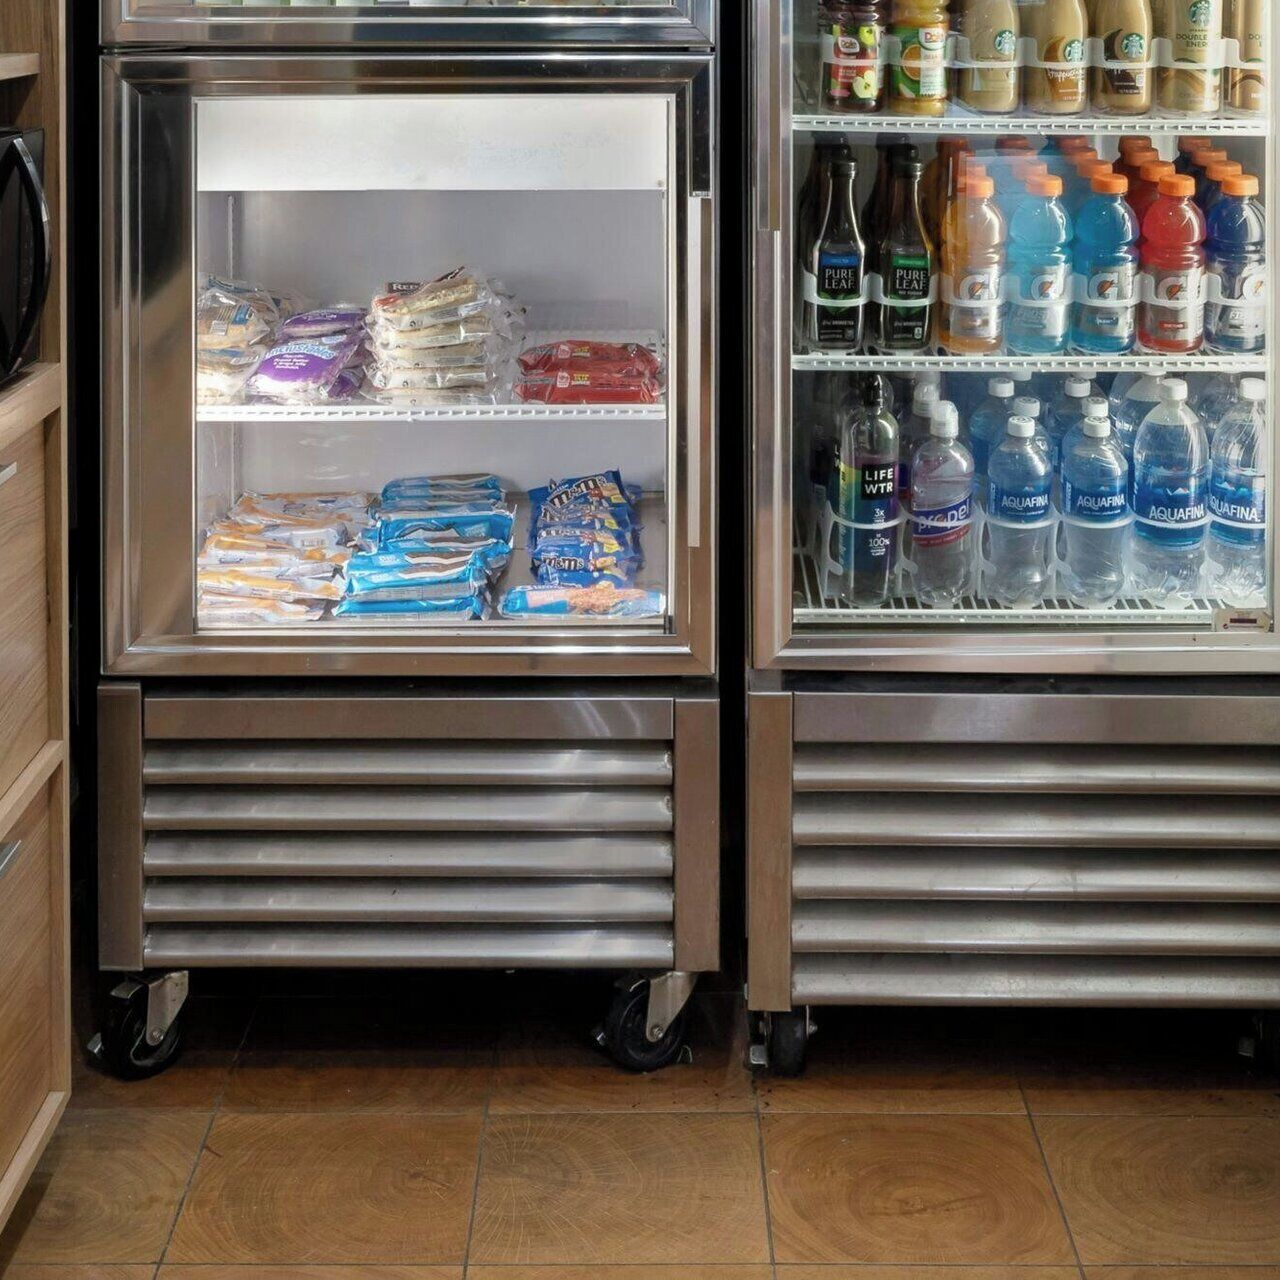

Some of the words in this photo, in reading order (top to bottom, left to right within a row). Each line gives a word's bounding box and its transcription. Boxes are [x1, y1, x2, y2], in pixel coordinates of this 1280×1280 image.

[825, 268, 855, 279] PURE
[896, 268, 927, 280] PURE
[825, 279, 854, 289] LEAF
[895, 279, 927, 290] LEAF
[865, 467, 894, 480] LIFE
[864, 483, 893, 494] WTR
[1001, 493, 1050, 510] AQUAFINA
[1076, 494, 1126, 511] AQUAFINA
[1149, 503, 1205, 523] AQUAFINA
